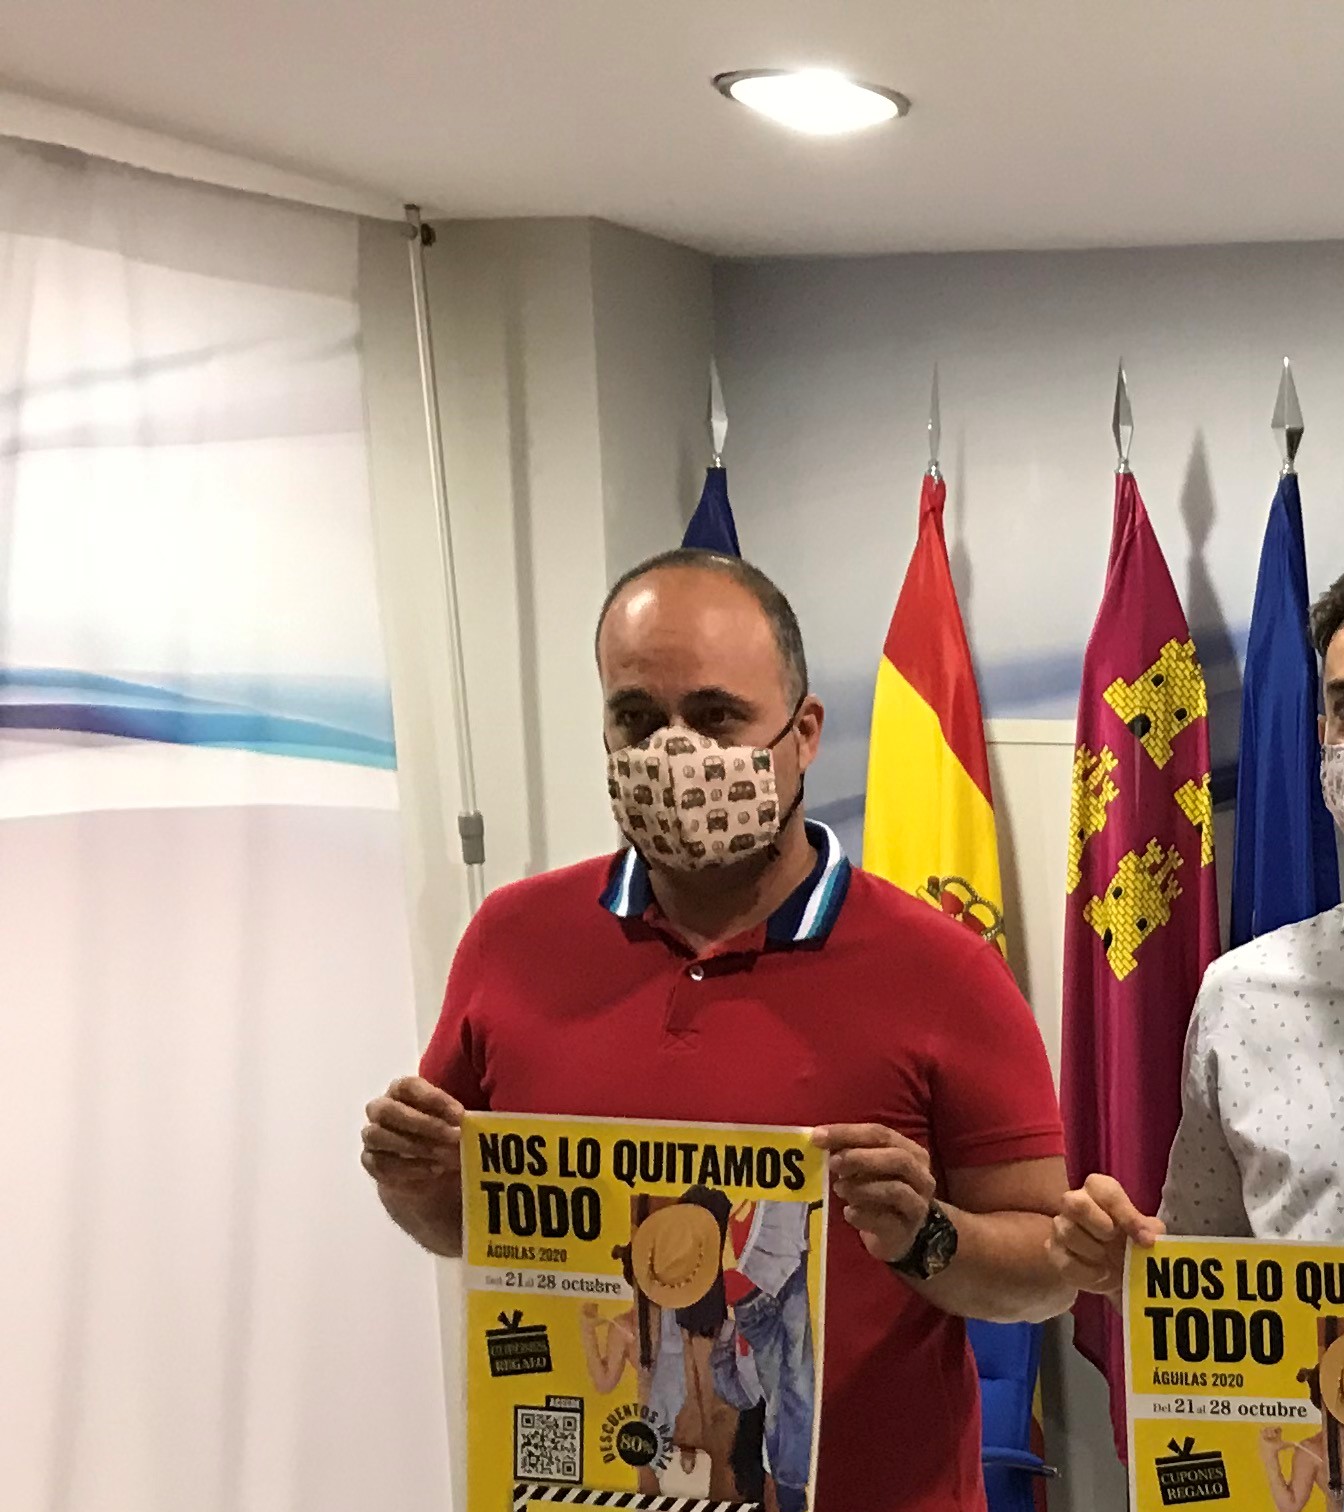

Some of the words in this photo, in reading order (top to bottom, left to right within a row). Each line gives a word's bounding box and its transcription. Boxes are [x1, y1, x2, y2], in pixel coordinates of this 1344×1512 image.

[478, 1132, 548, 1176] NOS
[559, 1136, 601, 1179] LO
[613, 1140, 805, 1190] QUITAMOS
[480, 1181, 602, 1241] TODO
[539, 1247, 567, 1262] 2020
[505, 1272, 523, 1286] 21
[537, 1274, 556, 1289] 28
[562, 1278, 621, 1294] octubre
[1146, 1256, 1224, 1300] NOS
[1237, 1259, 1283, 1303] LO
[1144, 1307, 1284, 1364] TODO
[1153, 1368, 1207, 1387] ÁGUILAS
[1211, 1372, 1243, 1388] 2020
[1153, 1402, 1171, 1413] Del
[1175, 1399, 1194, 1414] 21
[1197, 1405, 1206, 1415] al
[1209, 1400, 1231, 1415] 28
[1238, 1402, 1307, 1418] octubre
[599, 1402, 659, 1464] DESCUENTOS
[620, 1434, 654, 1454] 80%
[1161, 1467, 1223, 1485] CUPONES
[1167, 1483, 1223, 1500] REGALO
